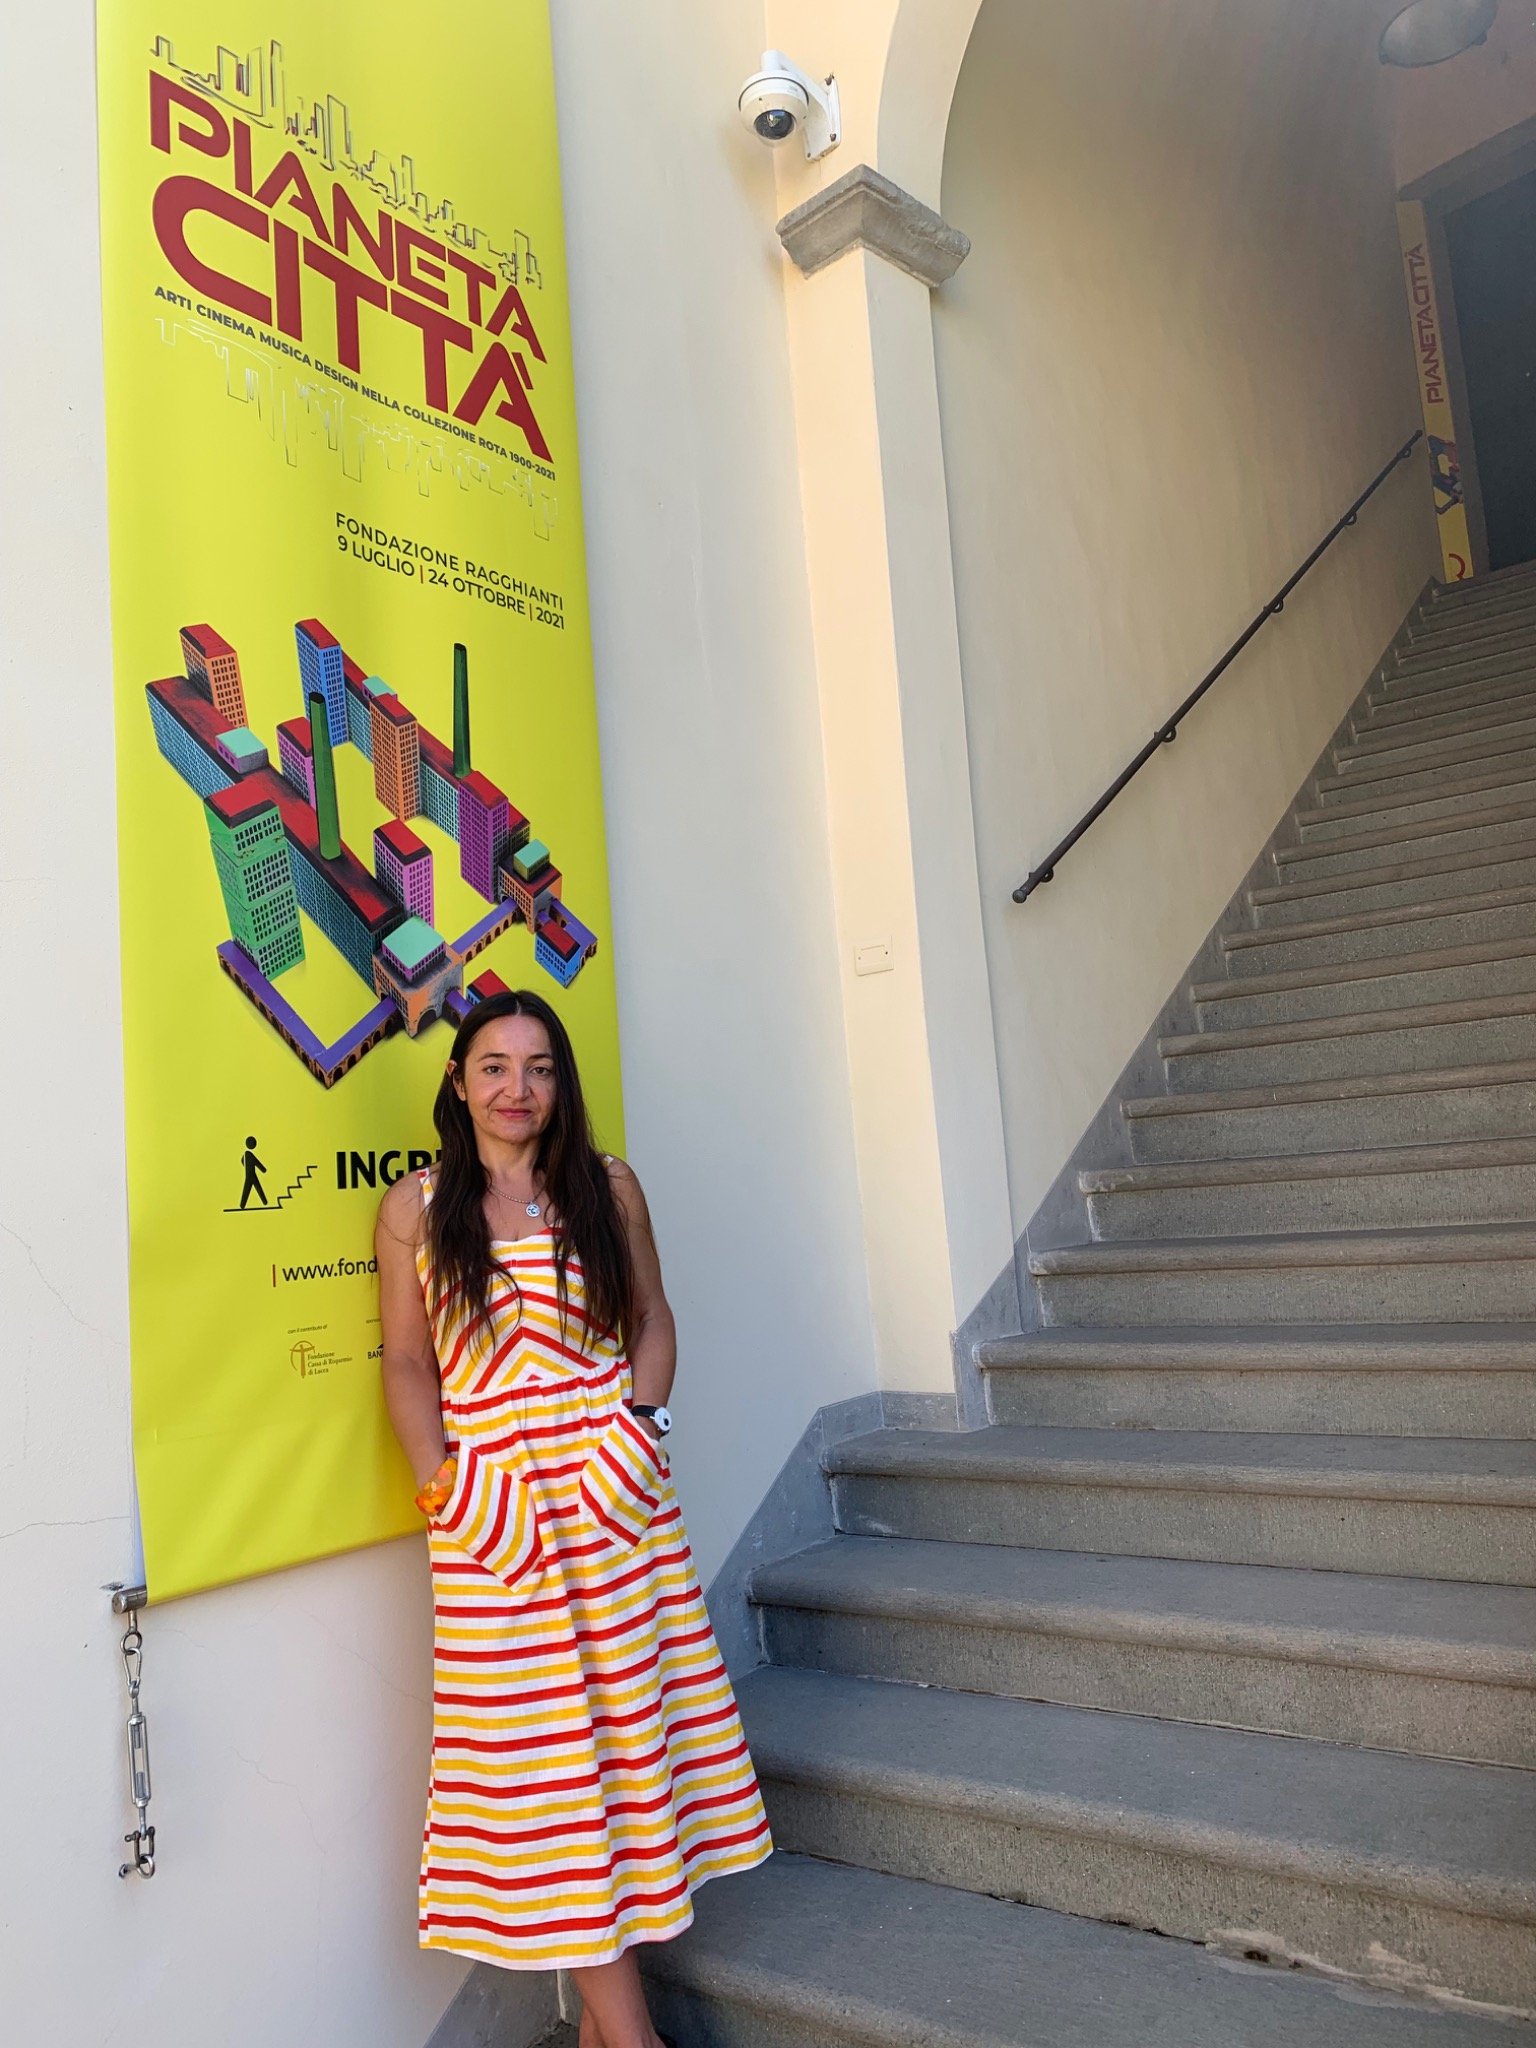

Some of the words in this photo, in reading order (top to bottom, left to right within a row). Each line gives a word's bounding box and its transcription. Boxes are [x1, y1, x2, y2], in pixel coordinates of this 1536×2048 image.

[149, 69, 547, 364] PIANETA
[152, 175, 553, 464] CITTÀ
[154, 286, 192, 310] ARTI
[196, 303, 255, 339] CINEMA
[259, 331, 311, 366] MUSICA
[314, 359, 359, 392] DESIGN
[361, 385, 400, 411] NELLA
[403, 405, 476, 443] COLLEZIONE
[478, 436, 508, 458] ROTA
[509, 451, 556, 481] 1900-2021
[336, 512, 459, 571] FONDAZIONE
[465, 560, 563, 611] RAGGHIANTI
[337, 535, 348, 551] 9
[352, 541, 415, 577] LUGLIO
[428, 569, 449, 587] 24
[452, 577, 526, 615] OTTOBRE
[536, 607, 565, 629] 2021
[336, 1150, 443, 1189] INGR
